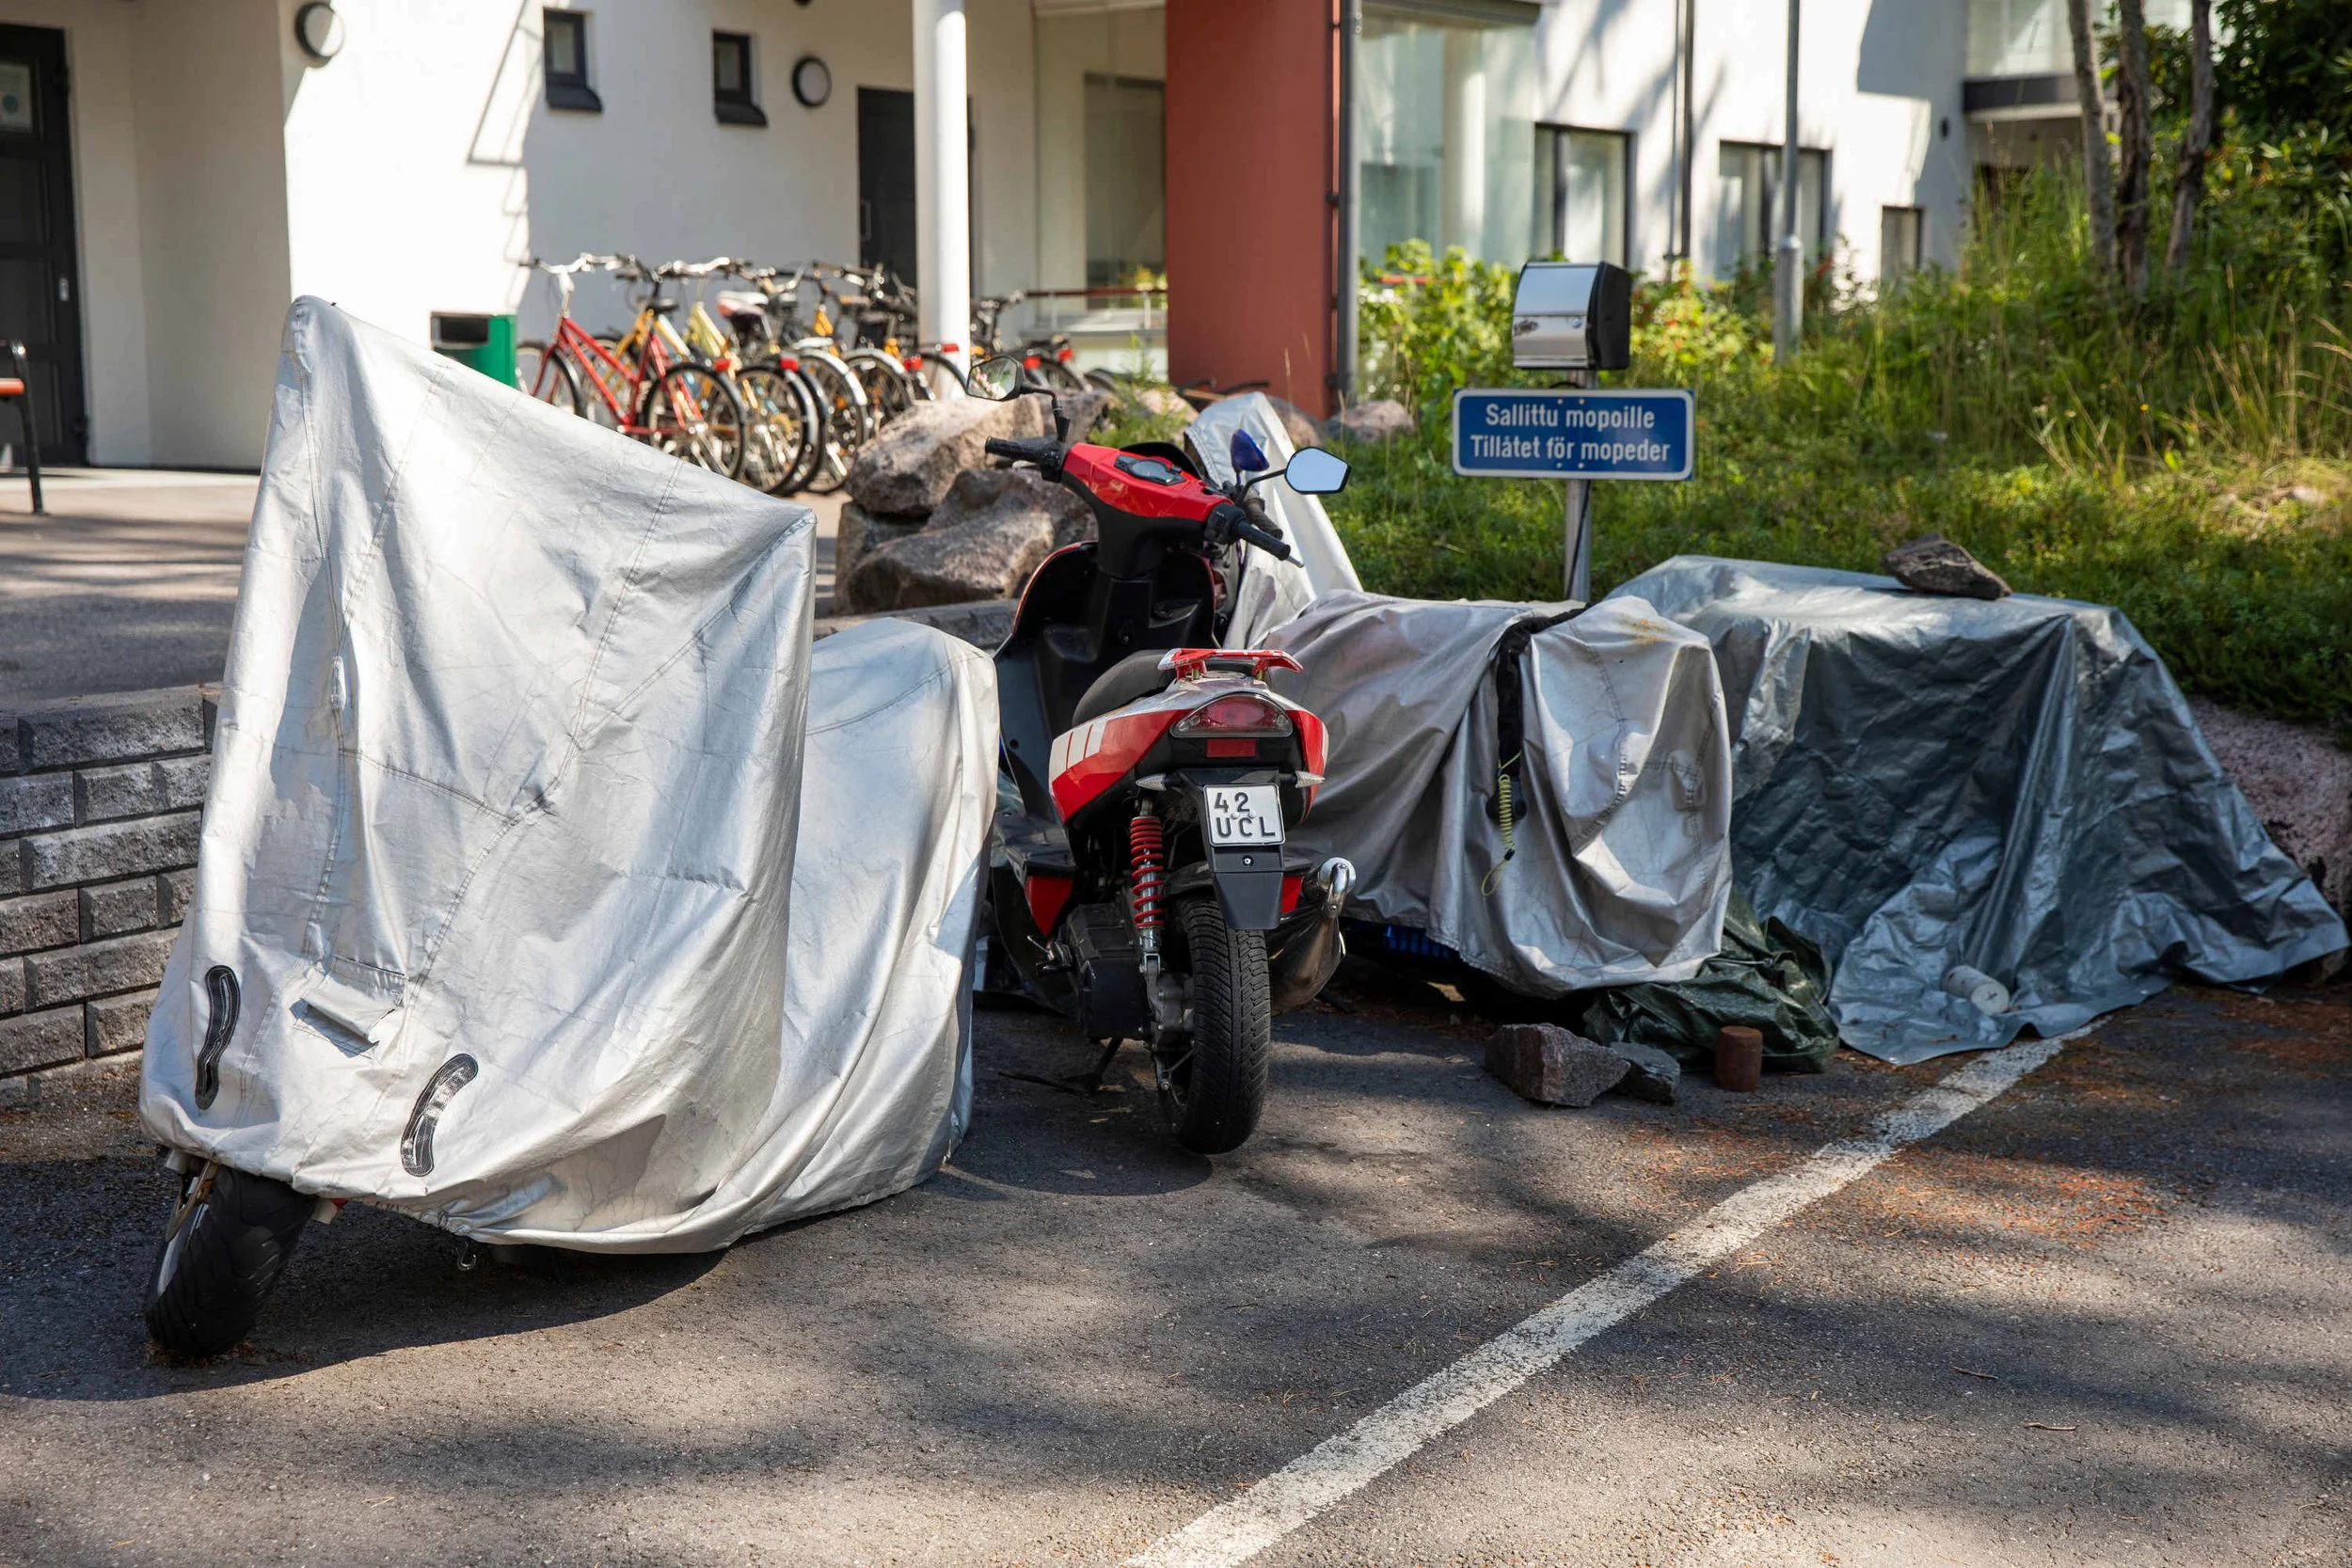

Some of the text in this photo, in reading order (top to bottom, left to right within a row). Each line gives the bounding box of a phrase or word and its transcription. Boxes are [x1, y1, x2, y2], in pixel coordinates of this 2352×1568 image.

[1486, 404, 1655, 432] Sallittu mopoille
[1470, 435, 1671, 464] Tillåtet för mopeder
[1215, 792, 1249, 814] 42
[1216, 816, 1275, 837] UCL
